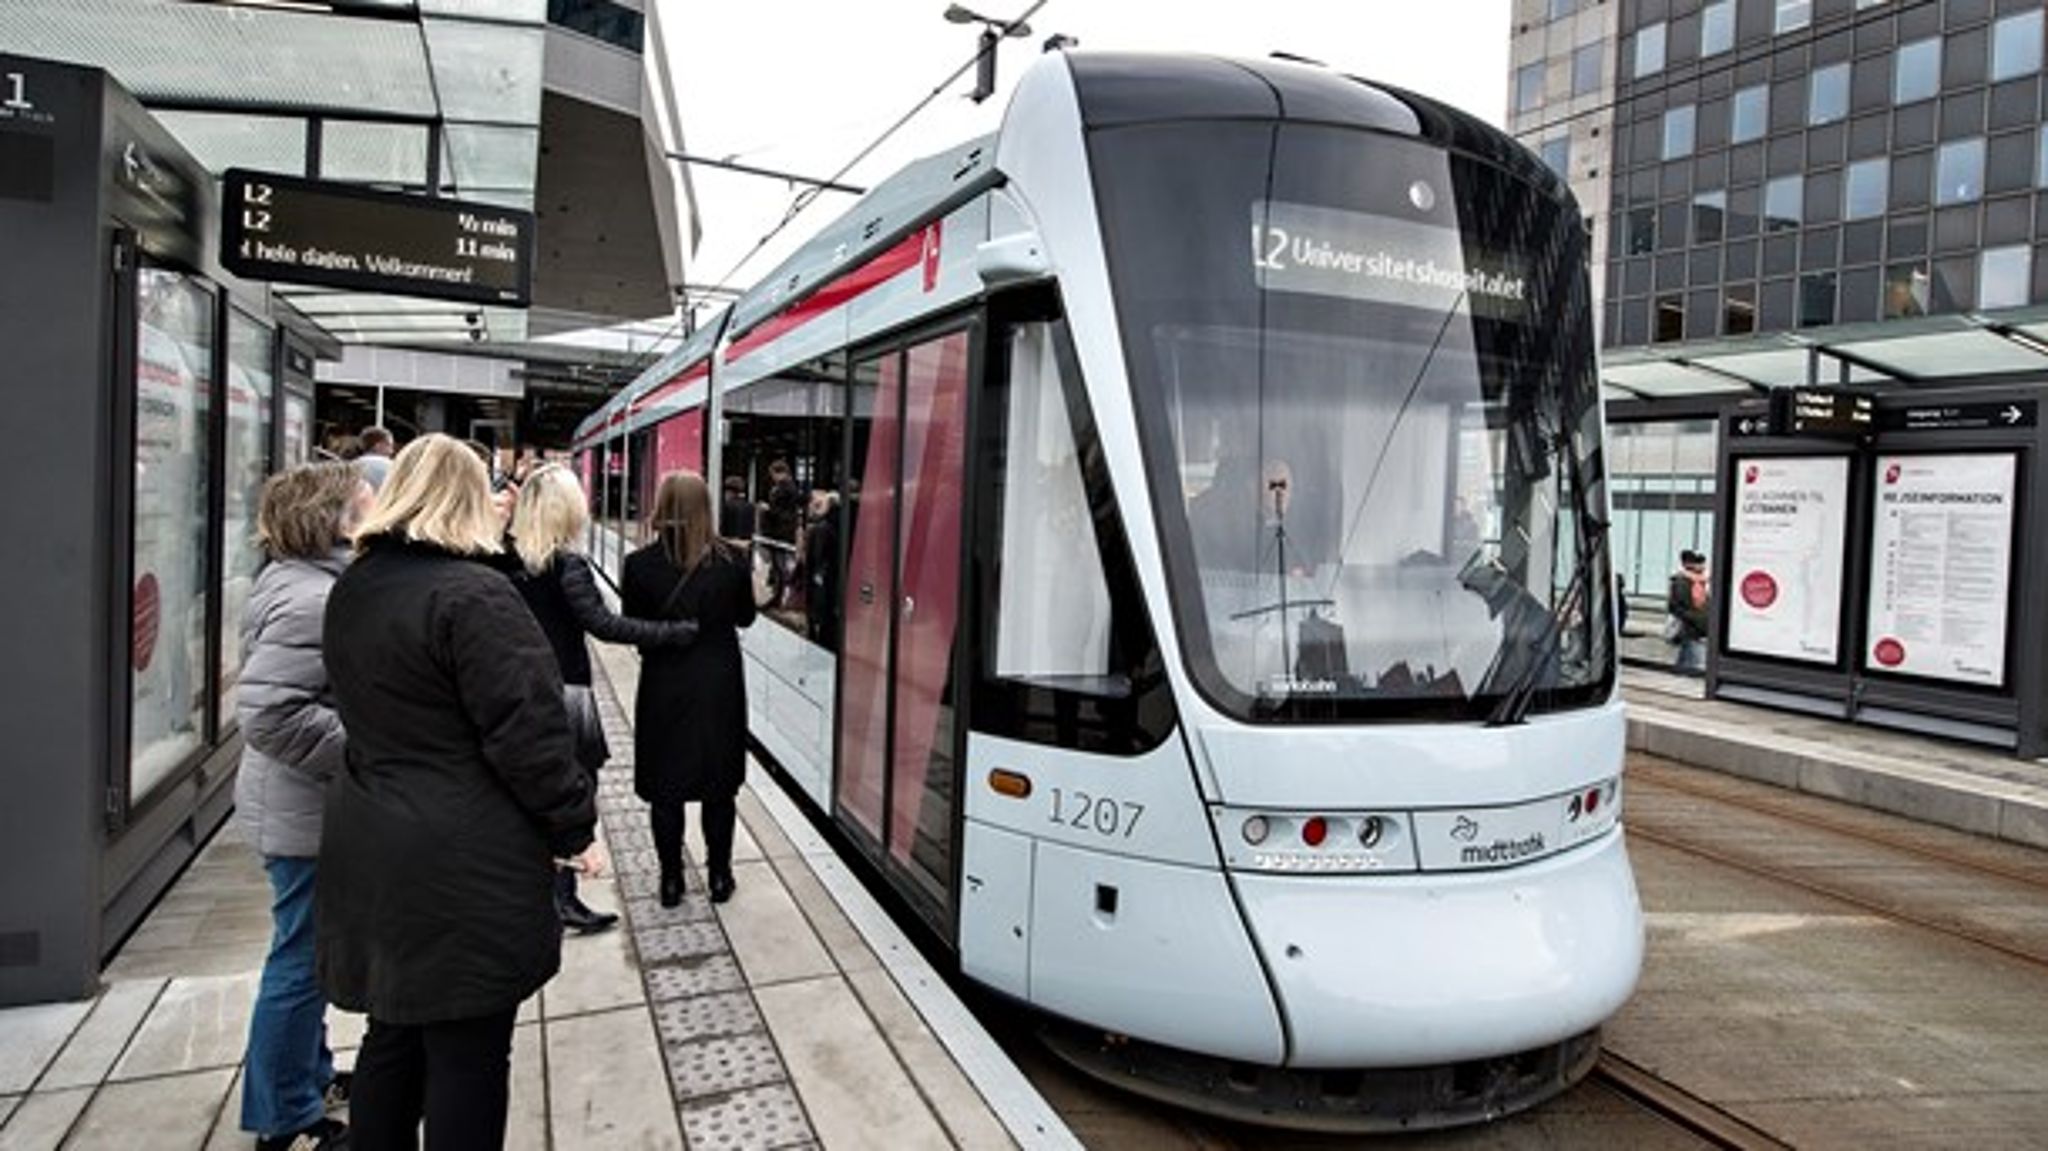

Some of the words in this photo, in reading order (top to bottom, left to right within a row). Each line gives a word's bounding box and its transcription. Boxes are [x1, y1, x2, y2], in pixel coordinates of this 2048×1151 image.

[4, 72, 33, 109] 1
[243, 183, 273, 205] L2
[243, 210, 271, 231] L2
[482, 217, 518, 236] min
[456, 237, 477, 257] 11
[480, 242, 516, 262] min
[1252, 224, 1287, 270] L2
[1292, 236, 1525, 300] Universitetshospitalet
[1049, 787, 1146, 838] 1207
